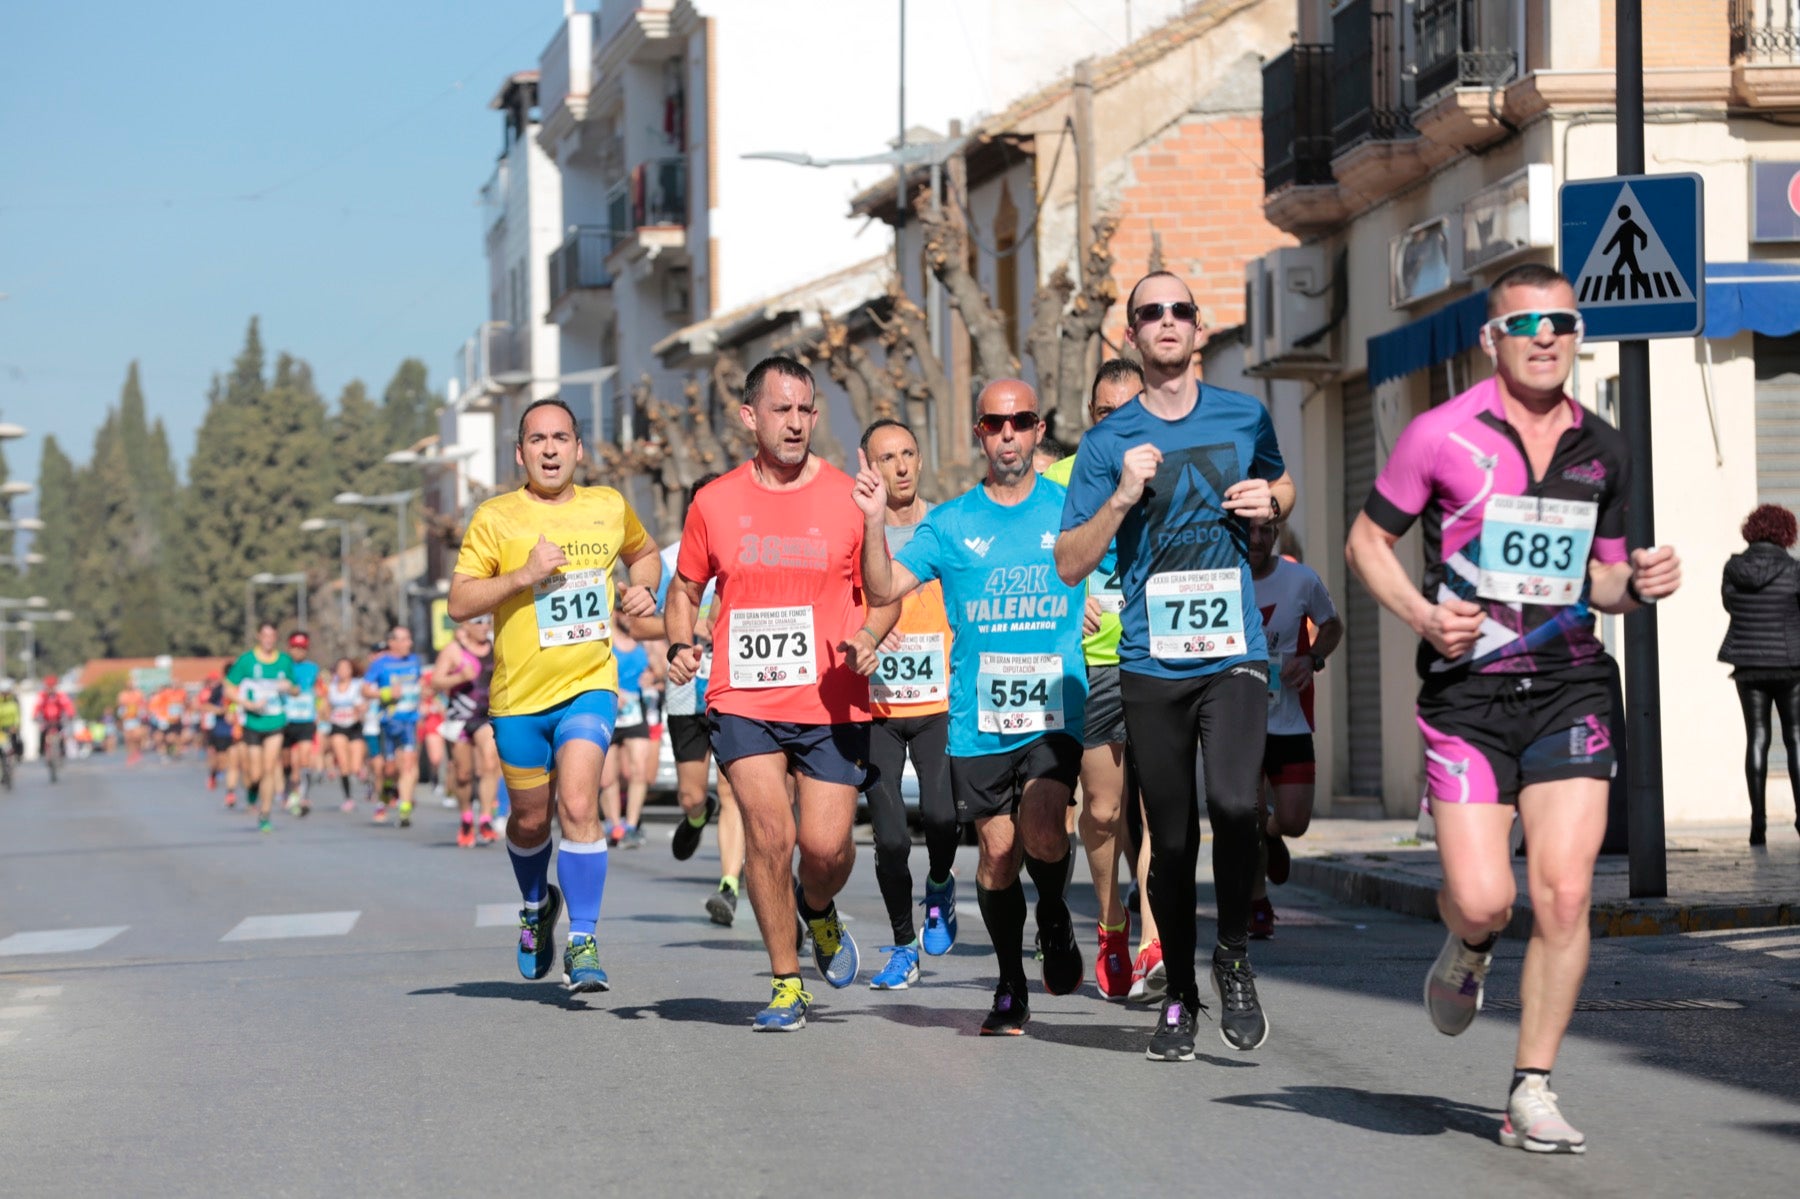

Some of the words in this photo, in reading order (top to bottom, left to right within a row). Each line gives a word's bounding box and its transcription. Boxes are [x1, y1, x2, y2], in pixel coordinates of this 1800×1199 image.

[560, 540, 609, 556] stinos
[738, 534, 782, 566] 38
[1502, 530, 1574, 571] 683
[985, 565, 1050, 596] 42K
[1188, 573, 1210, 582] PREMIO
[1211, 572, 1217, 581] DE
[550, 591, 600, 622] 512
[746, 611, 760, 620] GRAN
[760, 610, 780, 619] PREMIO
[781, 610, 788, 618] DE
[789, 608, 807, 617] FONDO
[965, 595, 1069, 623] VALENCIA
[1165, 597, 1229, 631] 752
[991, 623, 1008, 633] ARE
[1010, 621, 1057, 632] MARATHON
[739, 631, 808, 660] 3073
[882, 655, 934, 681] 934
[996, 655, 1011, 664] GRAN
[1011, 656, 1032, 665] PREMIO
[1033, 656, 1039, 665] DE
[1040, 655, 1055, 664] FON
[1003, 665, 1036, 674] DIPUTACIÓN
[991, 678, 1049, 708] 554
